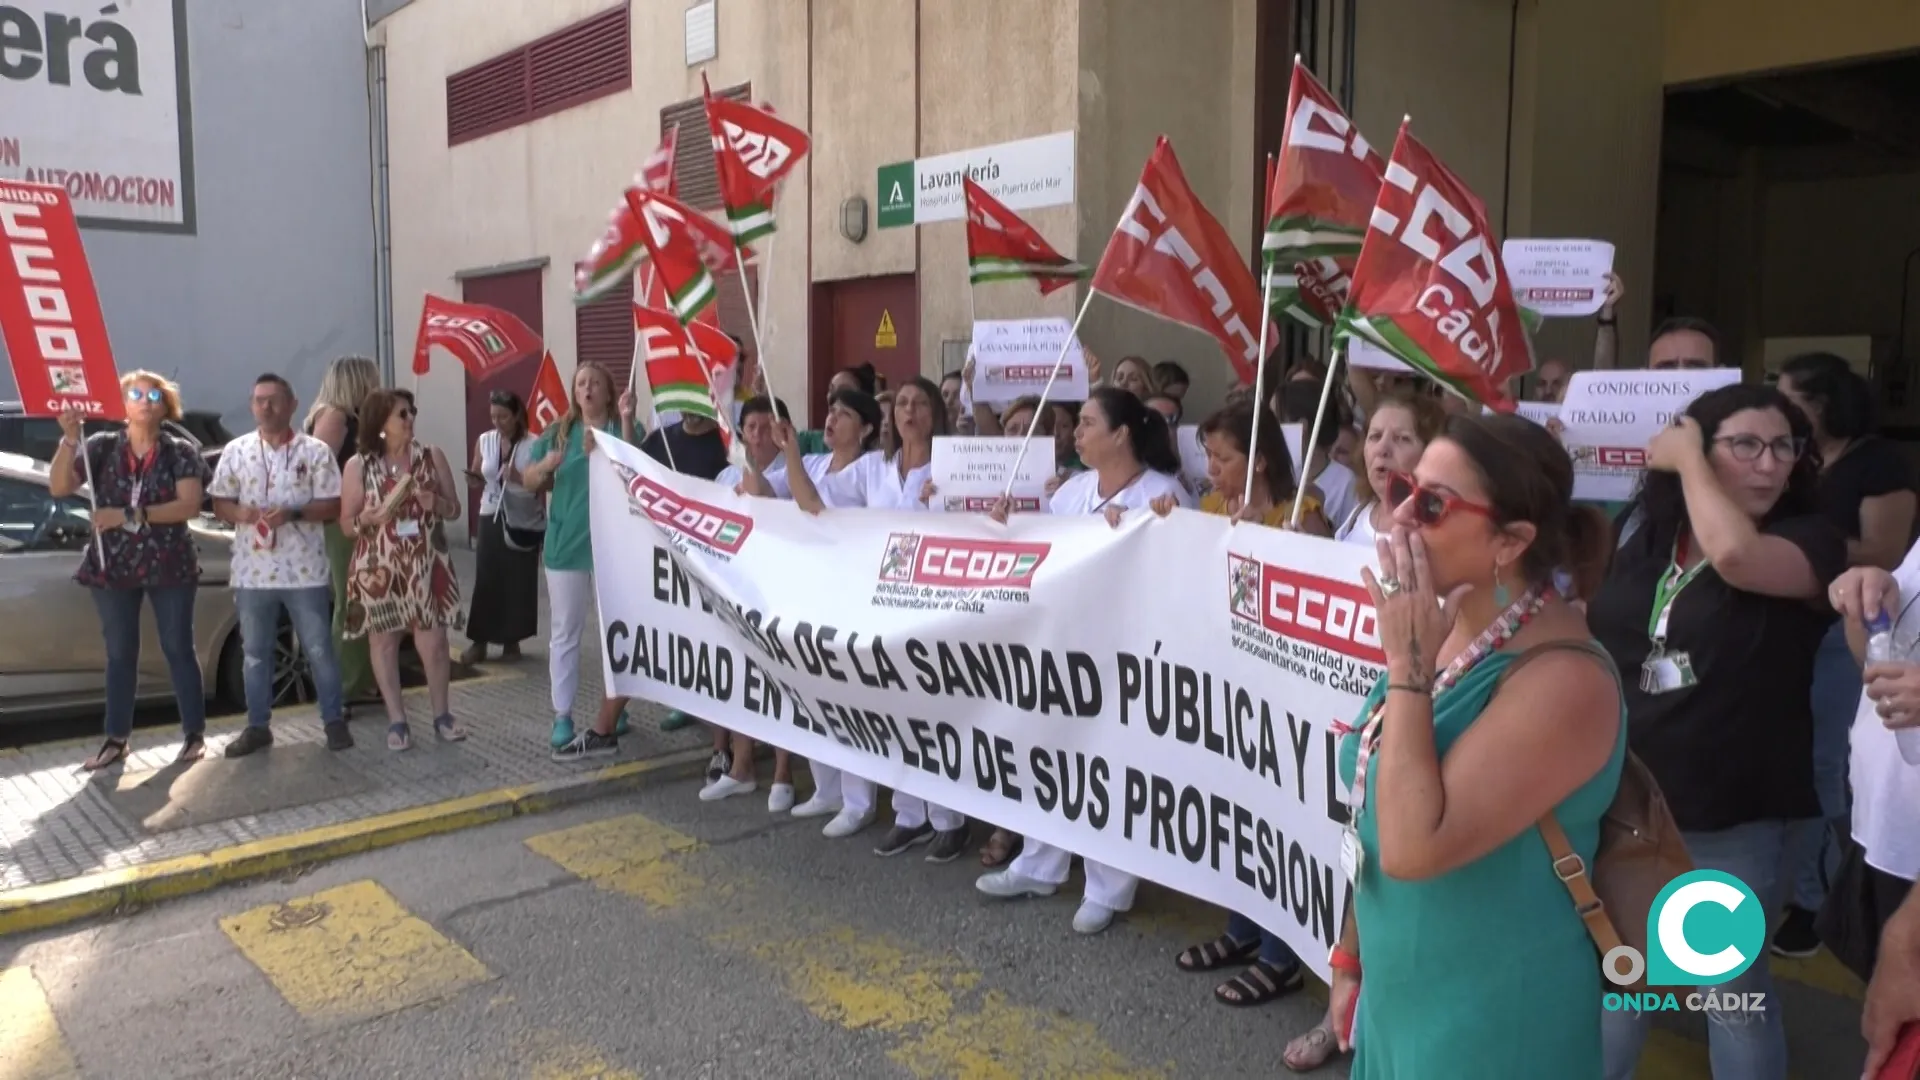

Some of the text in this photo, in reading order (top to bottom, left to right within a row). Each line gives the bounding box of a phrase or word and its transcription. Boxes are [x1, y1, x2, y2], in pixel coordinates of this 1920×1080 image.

[0, 3, 143, 96] erá
[1001, 181, 1029, 196] Puerta
[1030, 178, 1043, 190] del
[1045, 176, 1062, 188] Mar
[1, 203, 83, 361] CCOO
[1587, 381, 1691, 397] CONDICIONES
[1569, 409, 1637, 425] TRABAJO
[921, 547, 1016, 581] CCOO
[920, 586, 934, 599] de
[1230, 618, 1274, 646] sindicato
[1275, 633, 1289, 654] de
[1291, 641, 1343, 676] sanidad
[1347, 659, 1356, 679] y
[653, 545, 691, 608] EN
[793, 620, 848, 682] DE
[846, 631, 907, 692] LA
[905, 637, 1103, 718] SANIDAD
[1116, 640, 1282, 789] PÚBLICA
[1287, 711, 1312, 804] Y
[1309, 667, 1326, 686] de
[1328, 670, 1372, 698] Cádiz
[606, 619, 734, 703] CALIDAD
[743, 653, 782, 721] EN
[815, 697, 961, 782] EMPLEO
[972, 727, 1023, 803] DE
[1029, 745, 1111, 832] SUS
[1122, 766, 1354, 952] PROFESION
